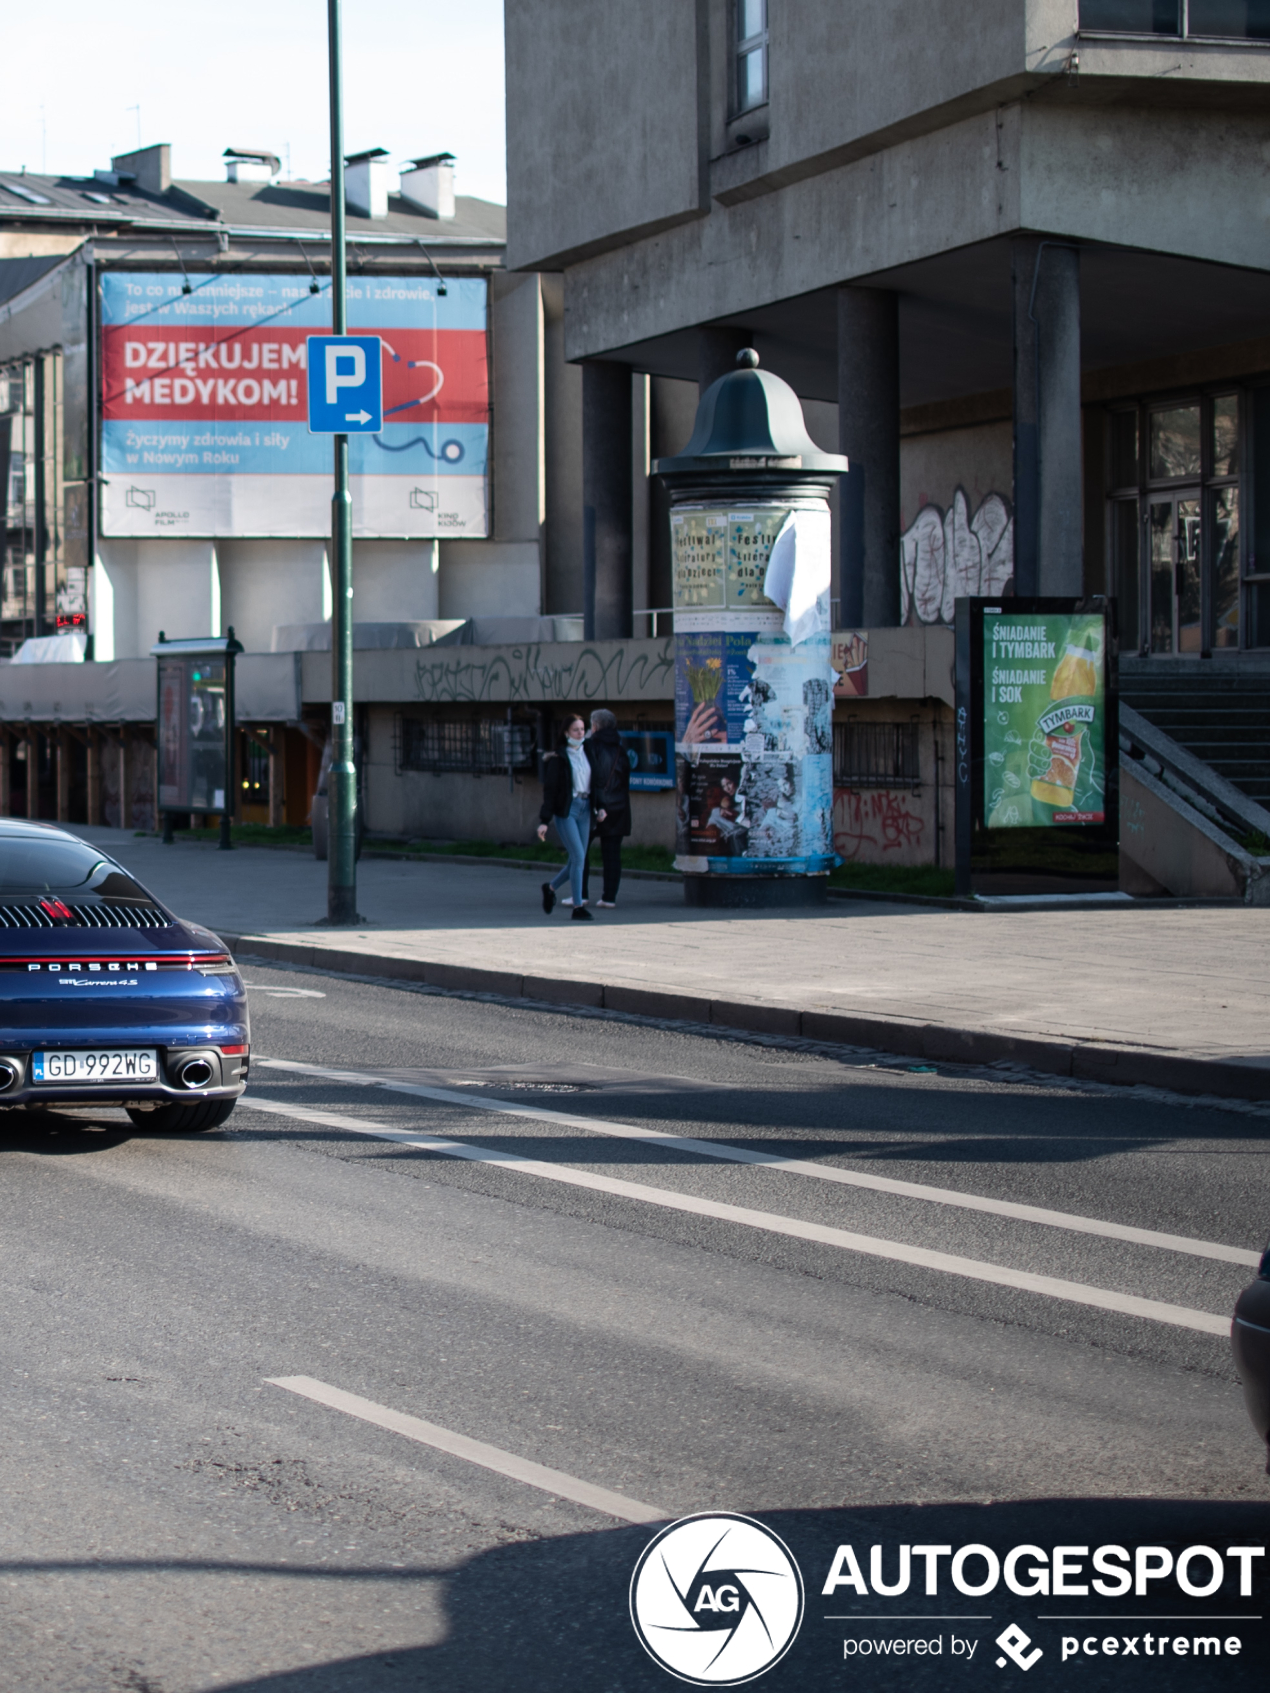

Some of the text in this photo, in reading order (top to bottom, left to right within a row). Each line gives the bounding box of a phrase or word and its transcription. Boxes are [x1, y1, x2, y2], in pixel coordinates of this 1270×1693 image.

[125, 284, 143, 296] To
[146, 285, 164, 296] co
[167, 284, 263, 299] nacenniejsze
[281, 285, 323, 298] nase
[374, 285, 436, 302] zdrowie,
[125, 301, 293, 319] jest w Waszych rękach
[124, 341, 307, 377] DZIĘKUJEM
[324, 345, 367, 404] P
[124, 378, 299, 406] MEDYKOM!
[126, 430, 290, 450] Życzymy zdrowia i siły
[126, 451, 240, 467] w Nowym Roku
[154, 511, 190, 519] APOLLO
[437, 519, 467, 527] KIJÓW
[737, 566, 755, 578] dla
[725, 634, 752, 647] Pola
[992, 622, 1047, 641] ŚNIADANIE
[992, 642, 1056, 659] I TYMBARK
[991, 666, 1047, 685] ŚNIADANIE
[991, 686, 1023, 703] I SOK
[1042, 706, 1091, 730] TYMBARK
[27, 962, 158, 972] PORSCHE
[74, 979, 118, 987] Carrera
[48, 1054, 77, 1077] GD
[85, 1052, 152, 1077] 992WG
